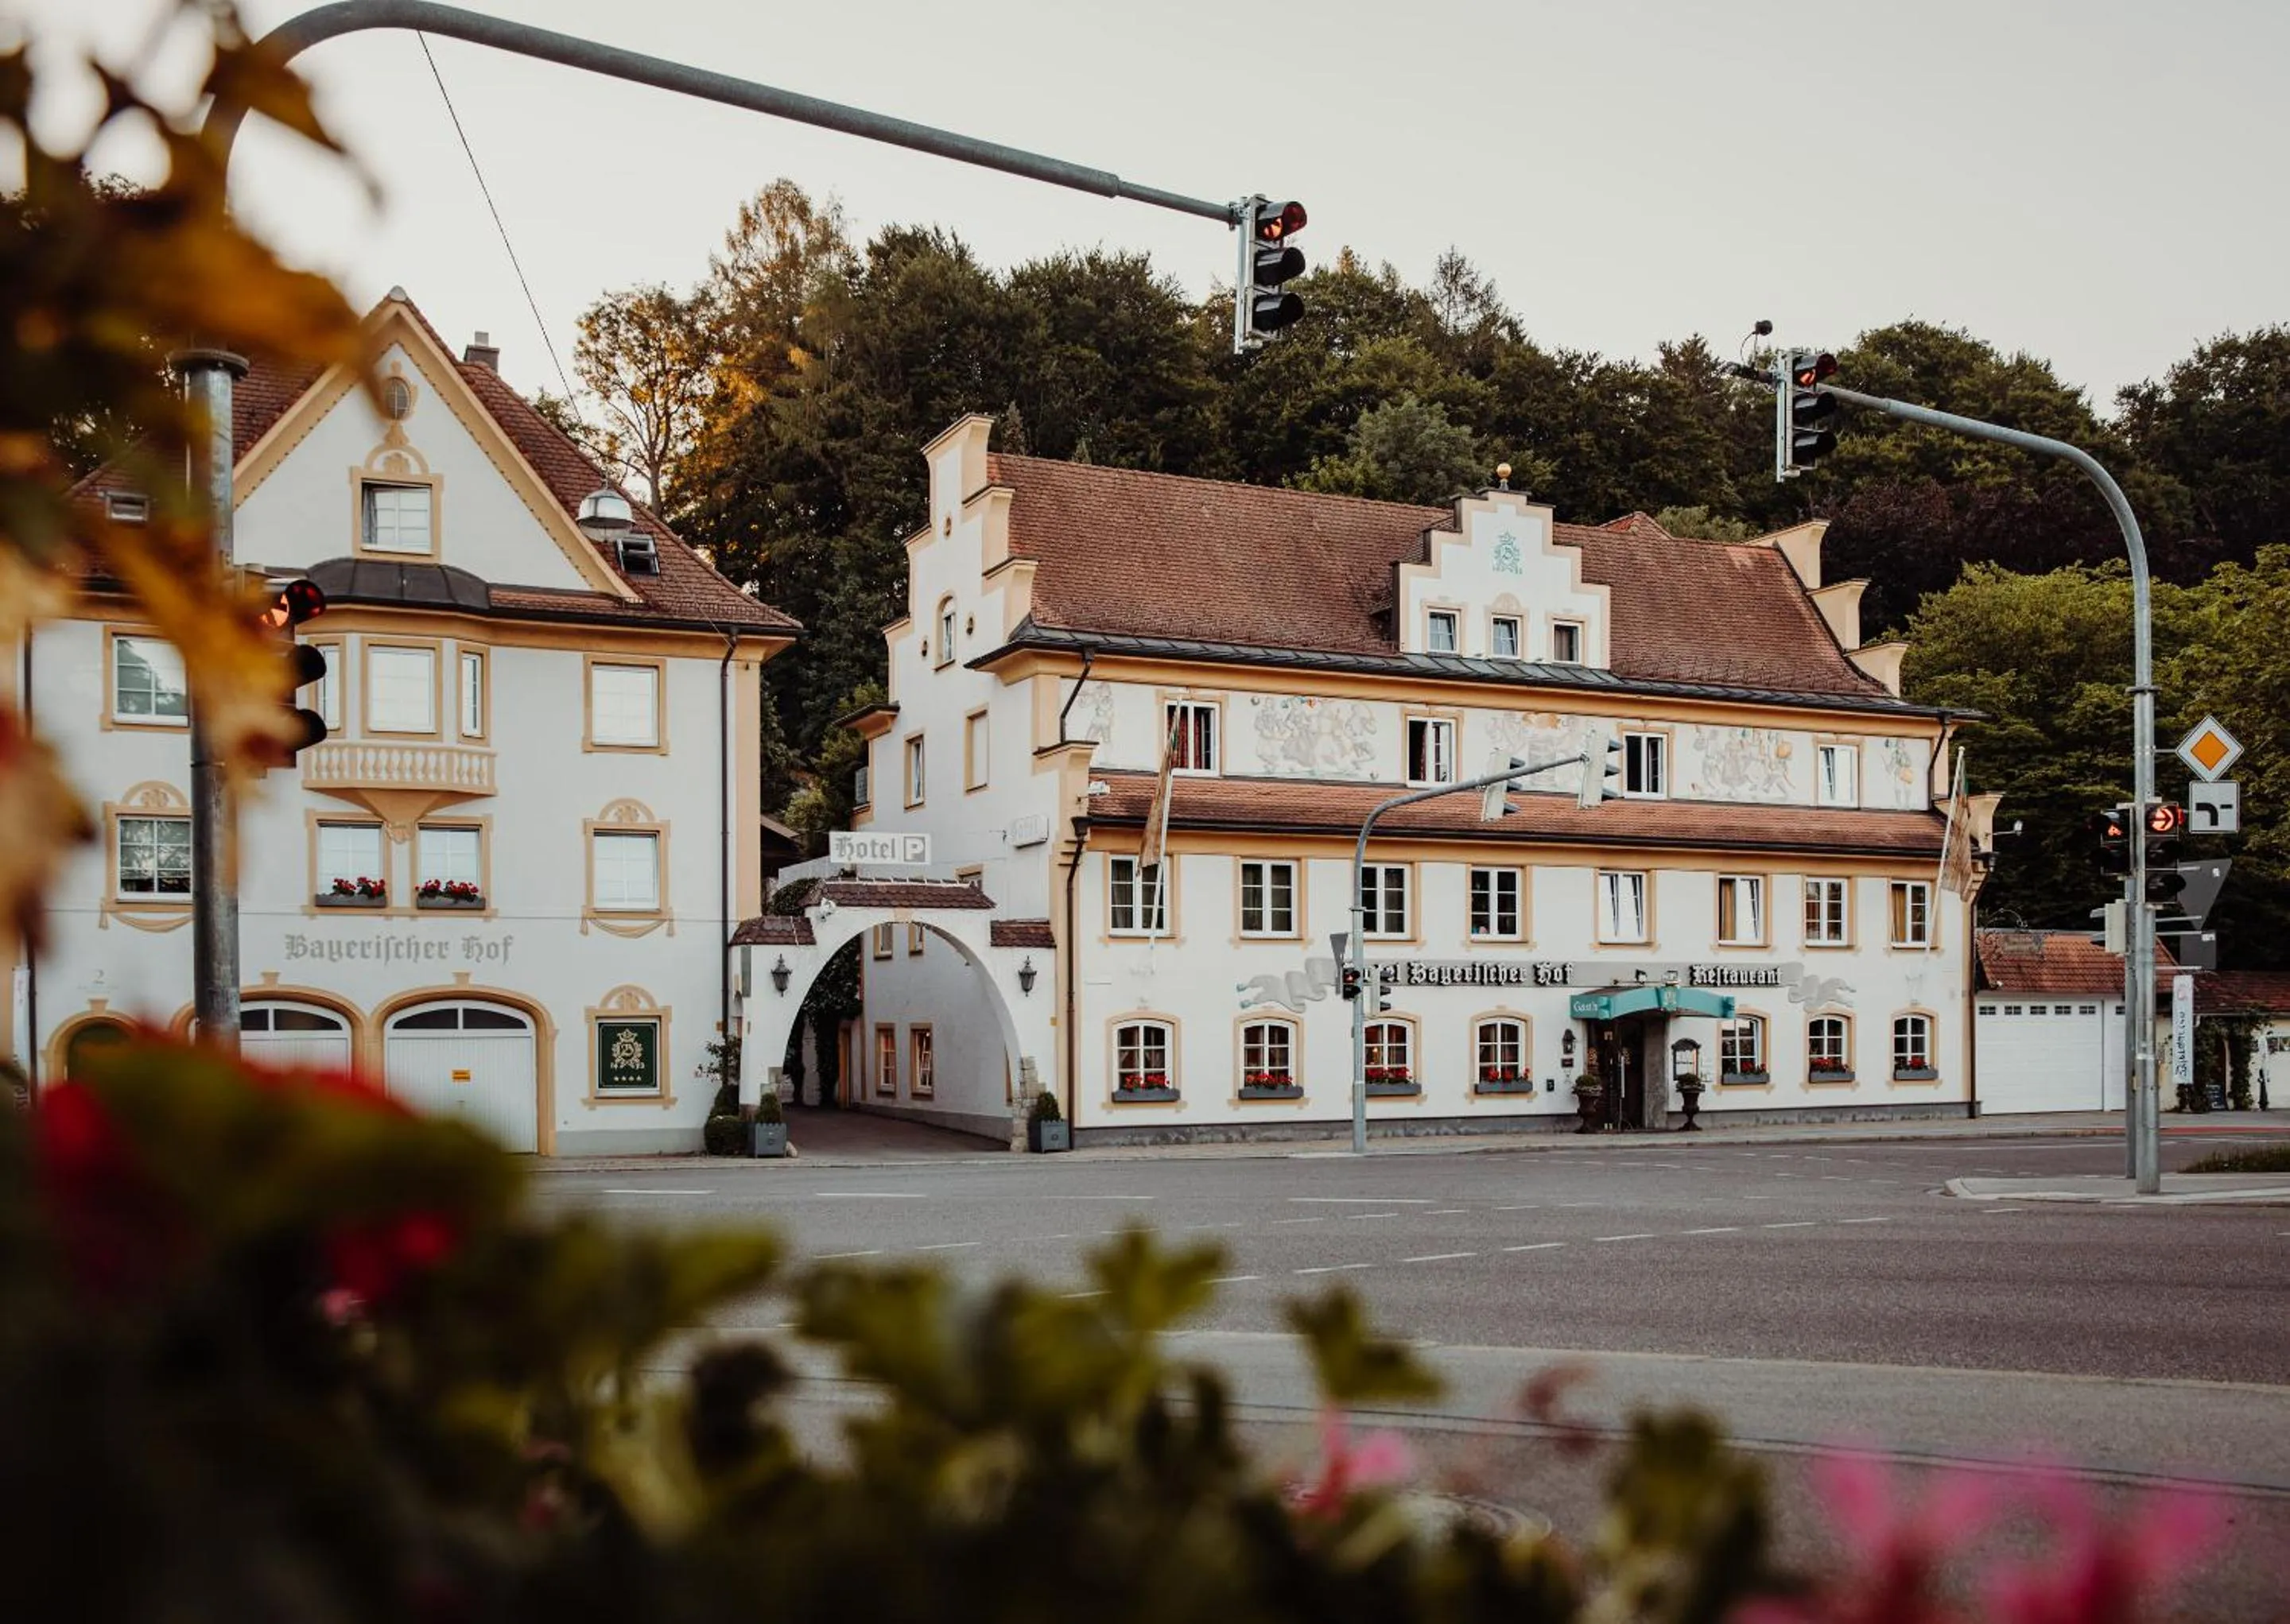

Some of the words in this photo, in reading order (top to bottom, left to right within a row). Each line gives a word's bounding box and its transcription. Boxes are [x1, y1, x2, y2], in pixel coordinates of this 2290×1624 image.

[835, 836, 895, 860] Hotel
[905, 836, 924, 861] P
[461, 935, 514, 965] Hof
[1533, 961, 1574, 985] Hof
